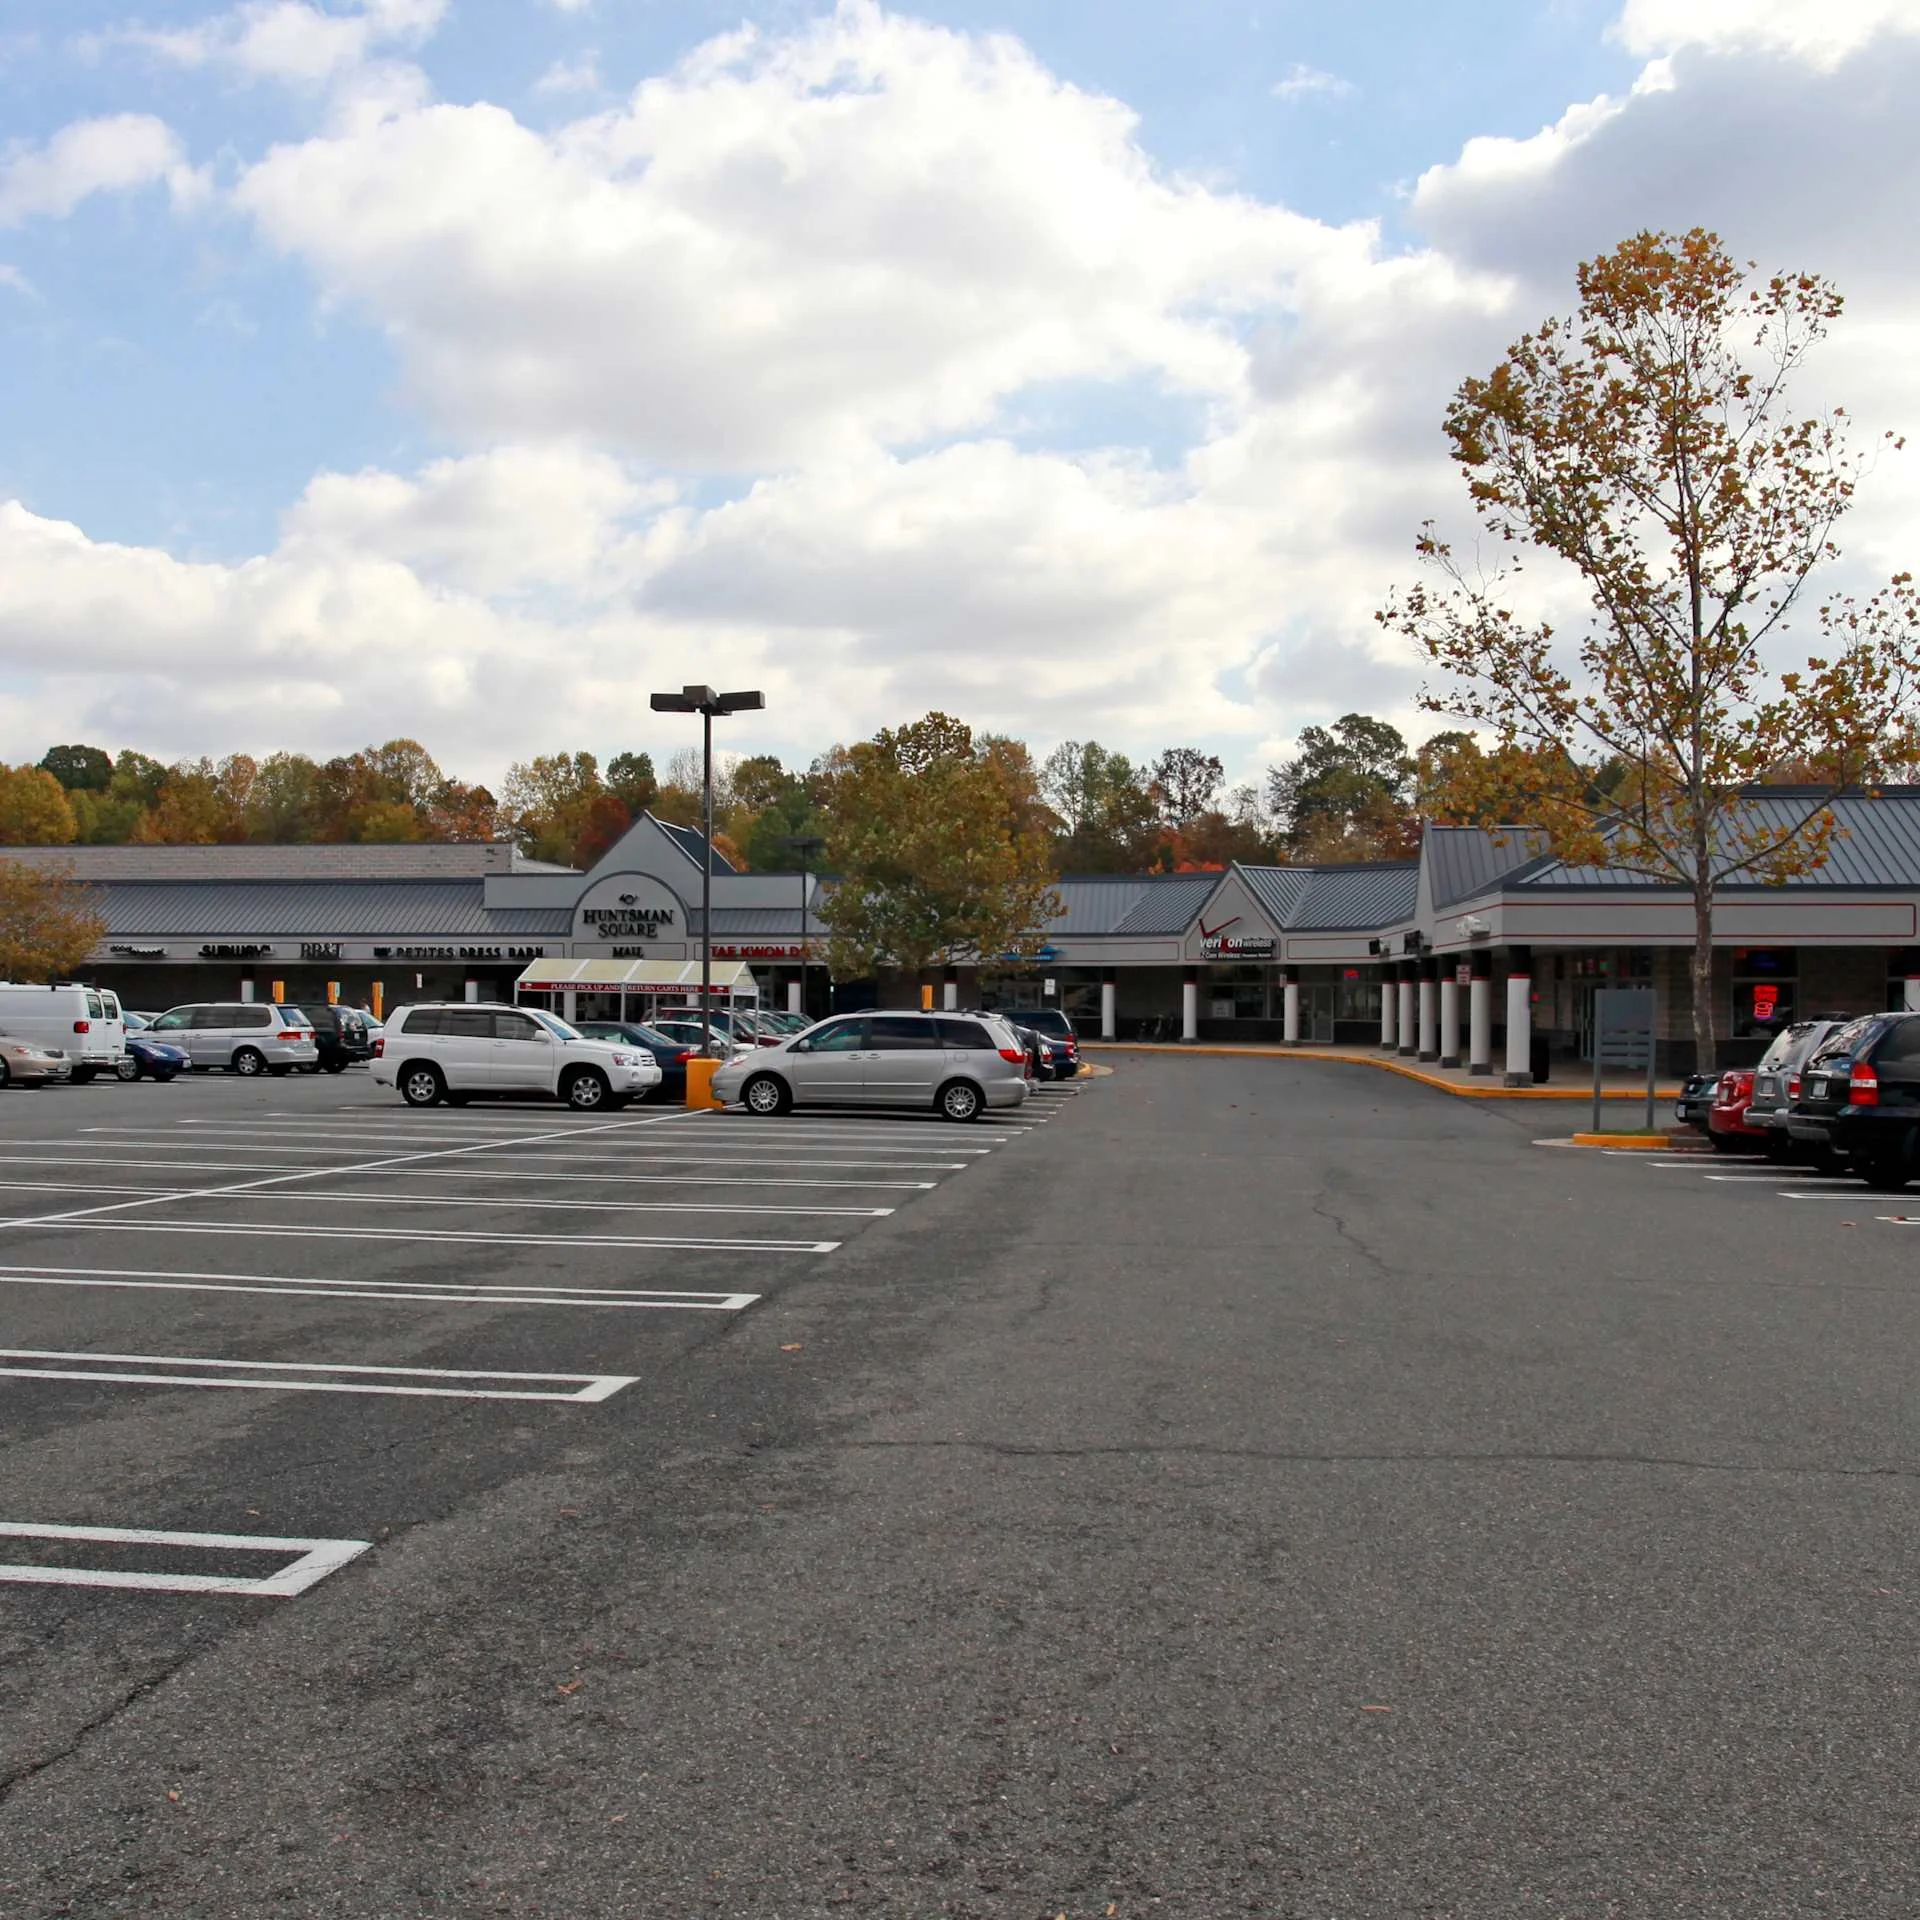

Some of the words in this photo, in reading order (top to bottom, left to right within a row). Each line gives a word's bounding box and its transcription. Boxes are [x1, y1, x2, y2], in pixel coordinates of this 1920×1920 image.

[583, 909, 674, 924] HUNTSMAN
[598, 923, 658, 938] SQUARE
[300, 942, 344, 959] BB&T
[710, 945, 736, 957] TAE
[741, 945, 785, 957] KWON
[1200, 935, 1243, 953] verizon
[397, 946, 455, 958] PETITES
[460, 947, 500, 958] DRESS
[508, 947, 543, 958] BARN
[680, 985, 699, 993] HERE
